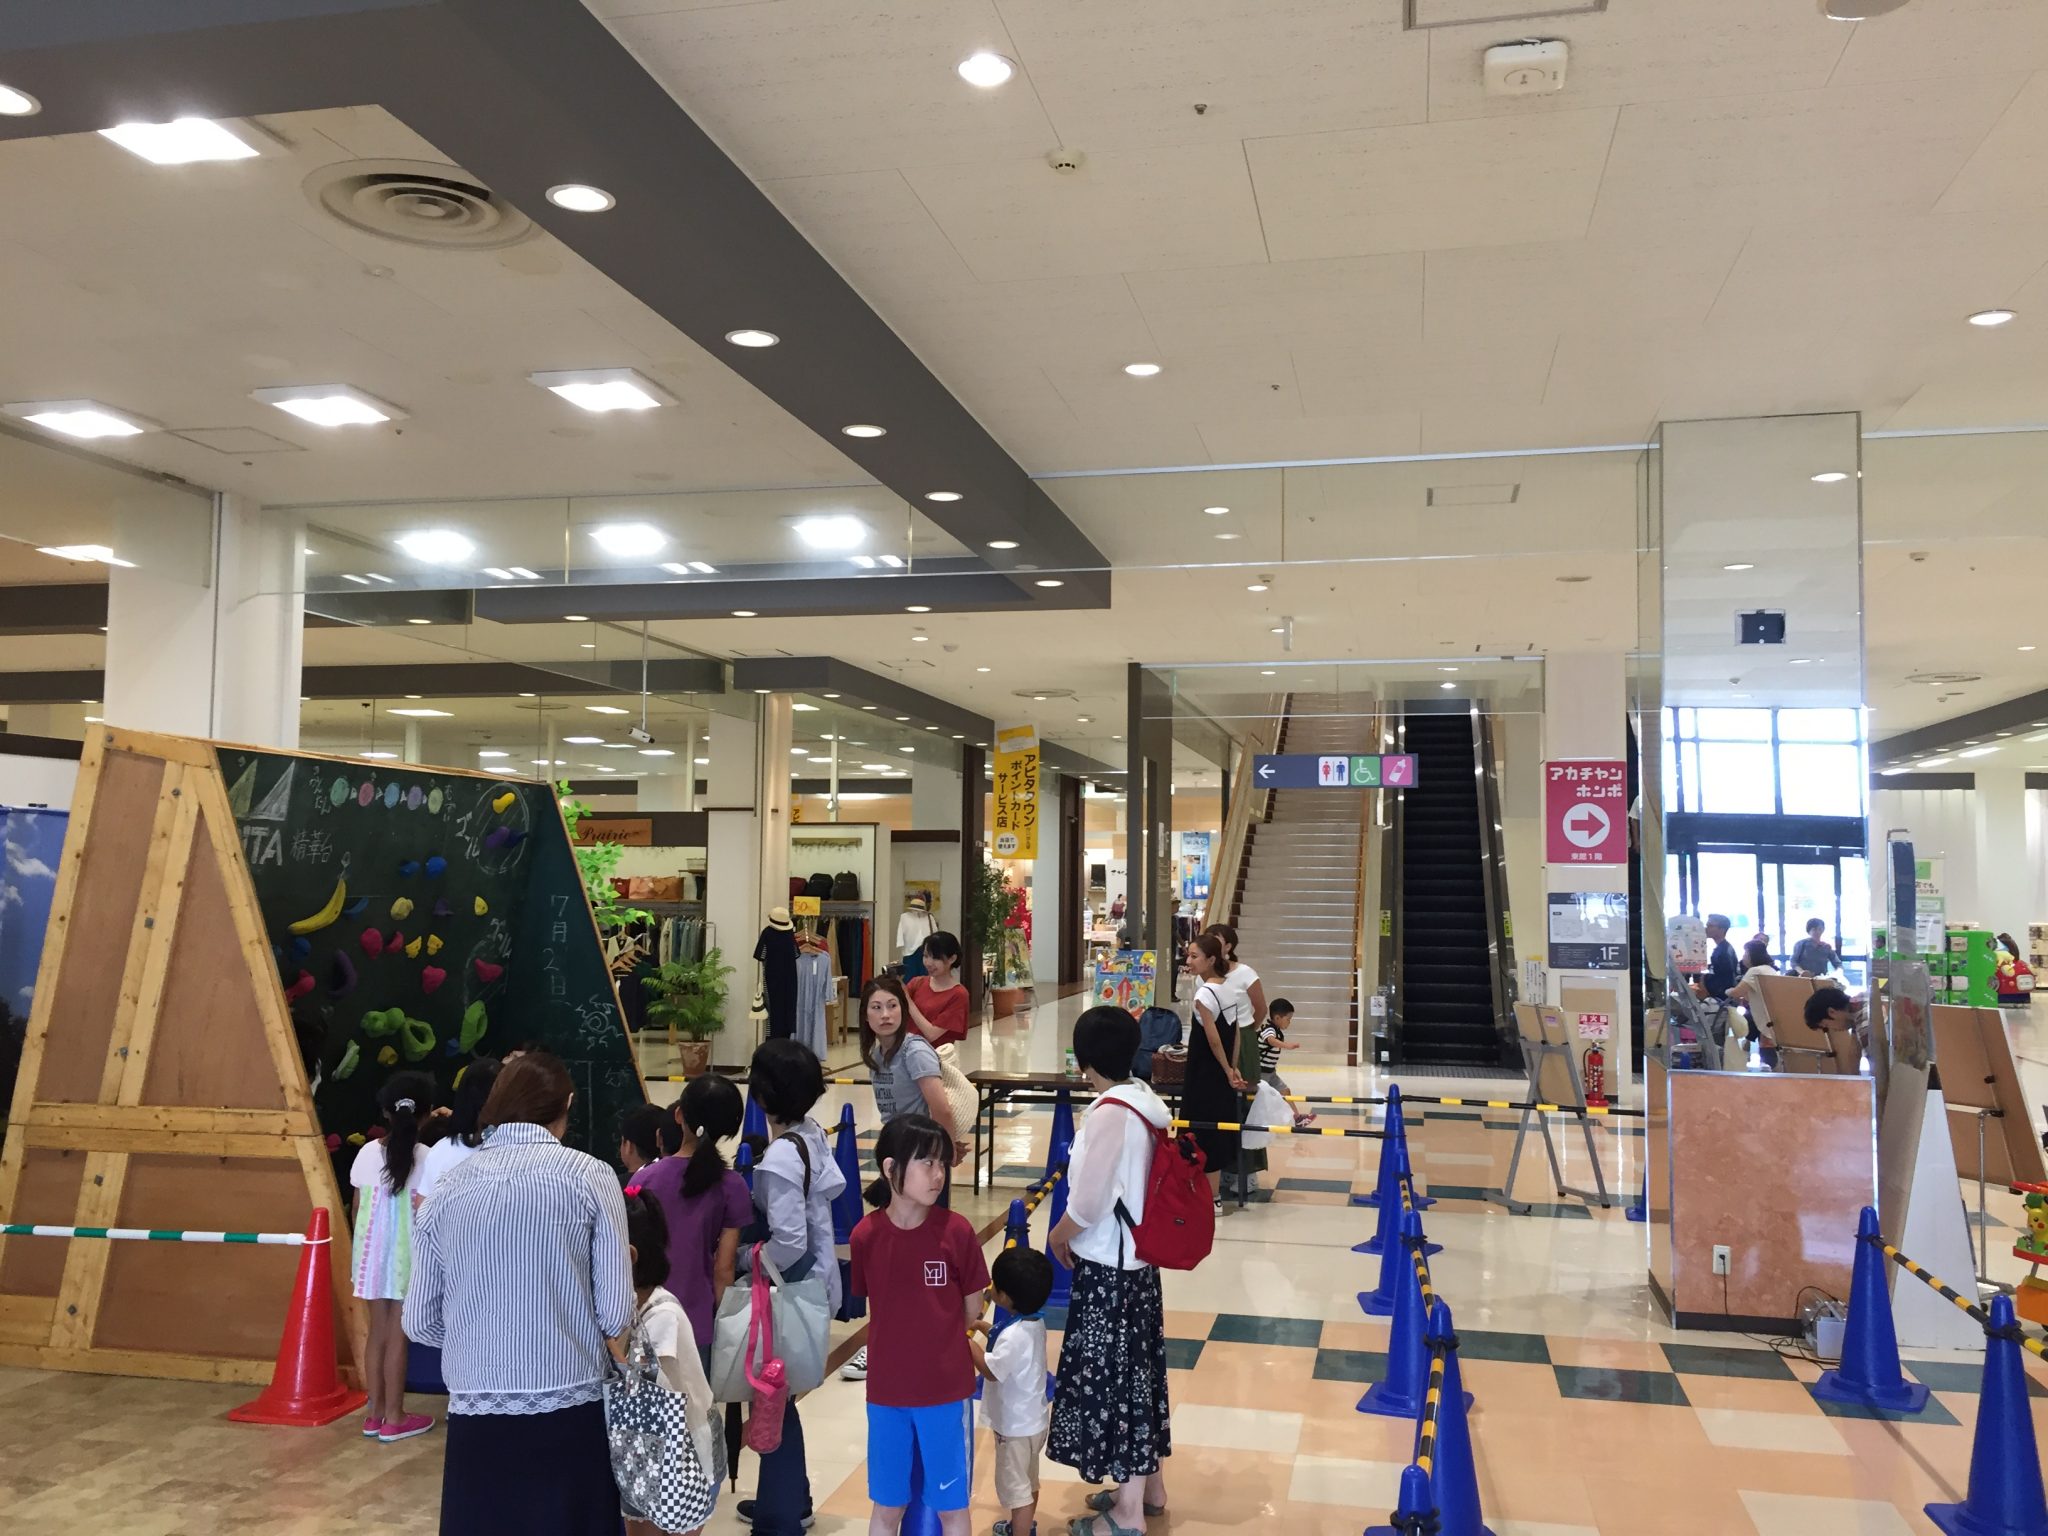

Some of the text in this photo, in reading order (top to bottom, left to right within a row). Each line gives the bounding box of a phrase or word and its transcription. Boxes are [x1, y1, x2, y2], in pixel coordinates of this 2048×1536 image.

[1023, 754, 1036, 828] アピタタウン
[1550, 766, 1622, 781] アカチャン
[1576, 783, 1622, 798] ホンポ
[996, 772, 1008, 829] サービス店
[1010, 760, 1022, 831] ポイントカード
[1600, 946, 1620, 960] 1F
